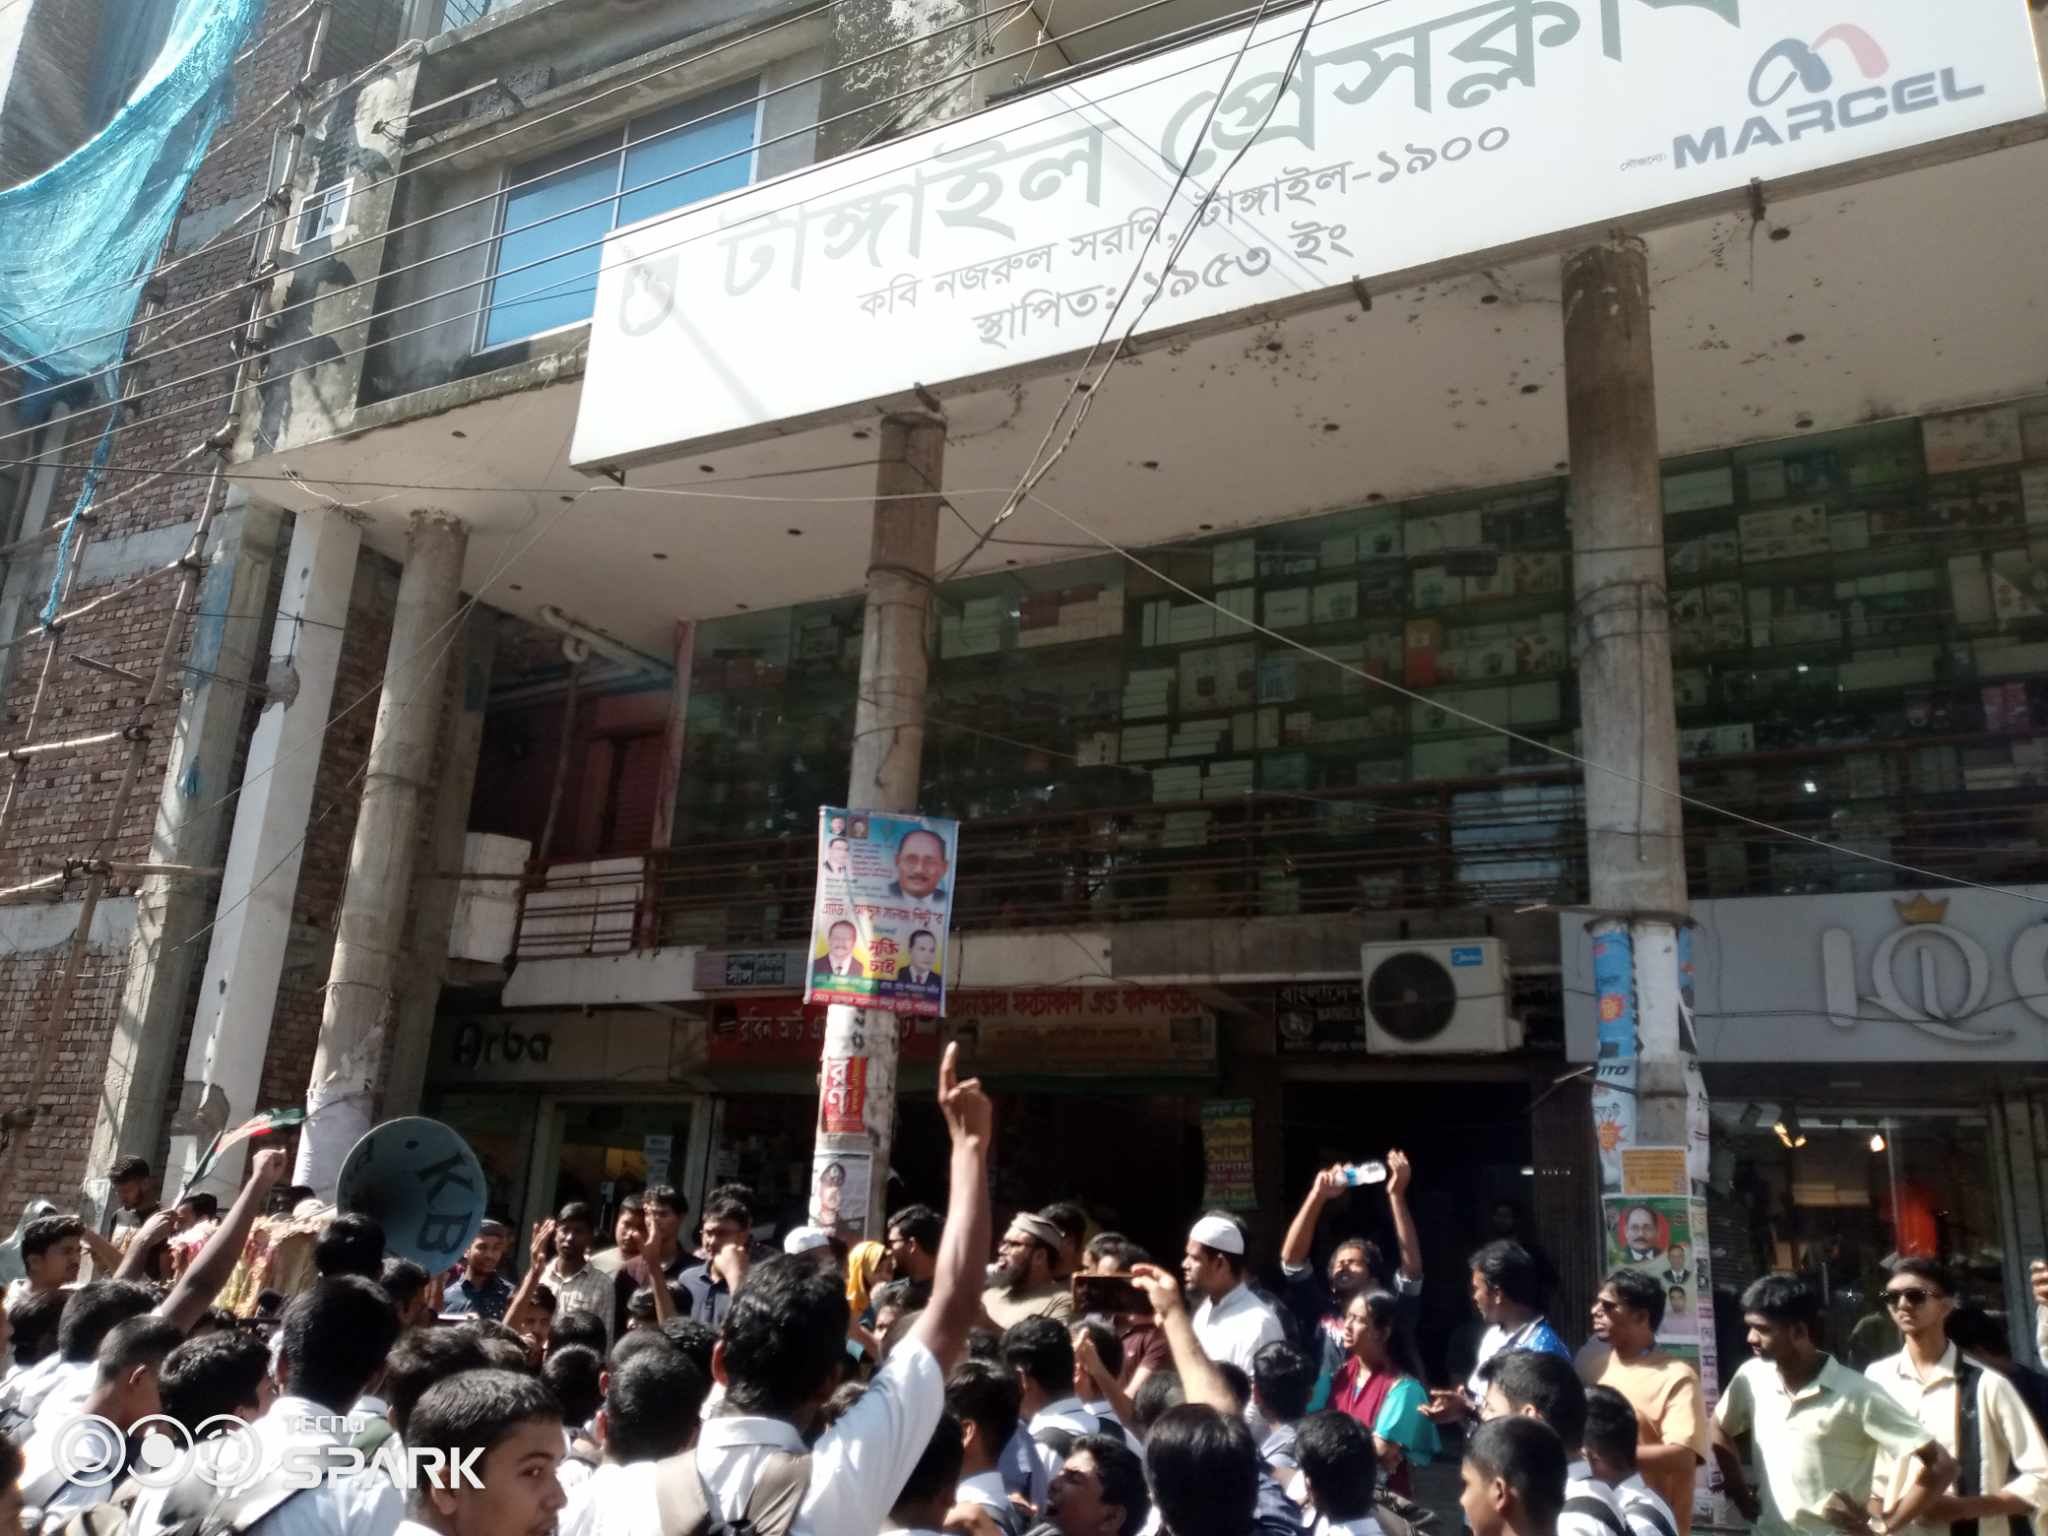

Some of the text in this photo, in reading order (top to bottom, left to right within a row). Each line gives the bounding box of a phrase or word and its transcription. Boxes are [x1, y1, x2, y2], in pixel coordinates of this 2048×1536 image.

[1673, 66, 1986, 169] MARCEL
[717, 123, 1112, 300] টাঙ্গাইল
[857, 273, 918, 320] কবি
[932, 243, 1057, 298] নজরুল
[1141, 245, 1273, 306] ১৯৫৩
[1288, 221, 1359, 266] ইং
[868, 958, 899, 977] চাই
[450, 1020, 554, 1071] Arba
